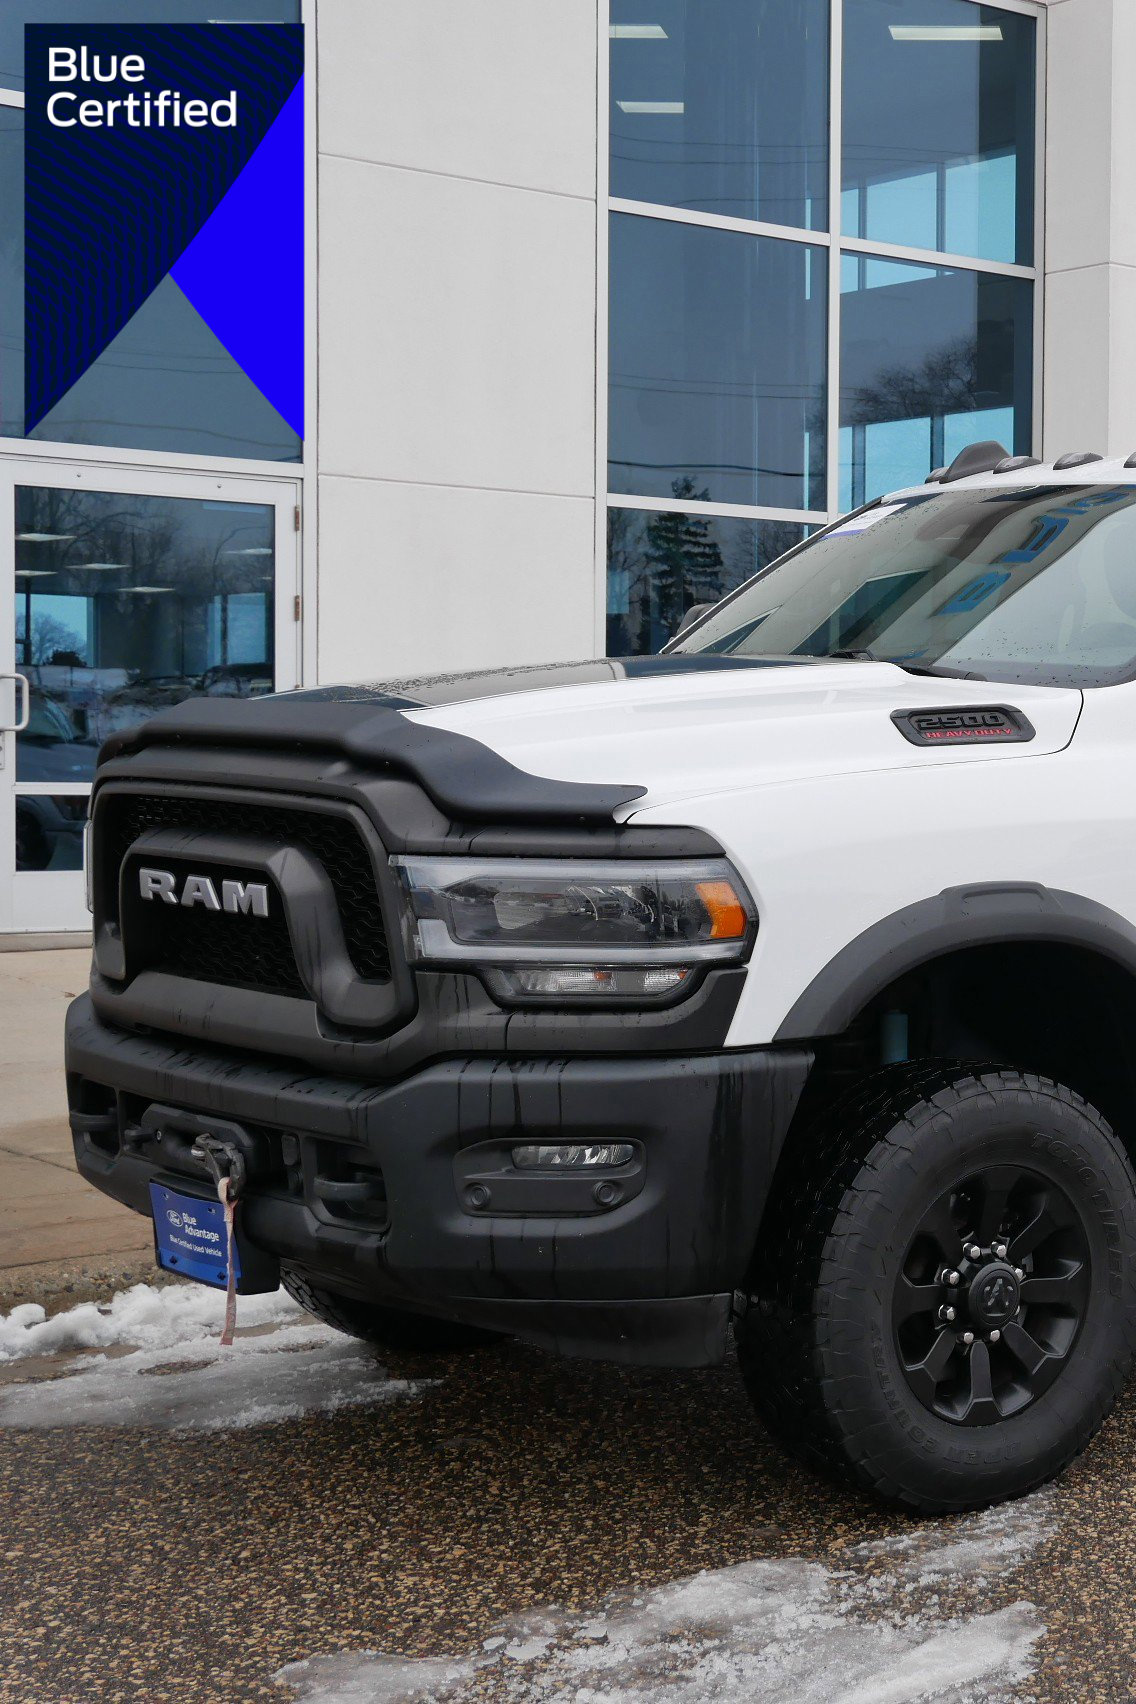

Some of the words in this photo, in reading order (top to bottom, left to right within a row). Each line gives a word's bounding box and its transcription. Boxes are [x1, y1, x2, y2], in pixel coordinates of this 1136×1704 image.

[916, 713, 1005, 730] 2500
[925, 729, 973, 739] HEAVY
[974, 727, 1013, 736] DUTY
[138, 867, 270, 918] RAM
[182, 1212, 197, 1225] Blue
[185, 1224, 219, 1242] Advantage
